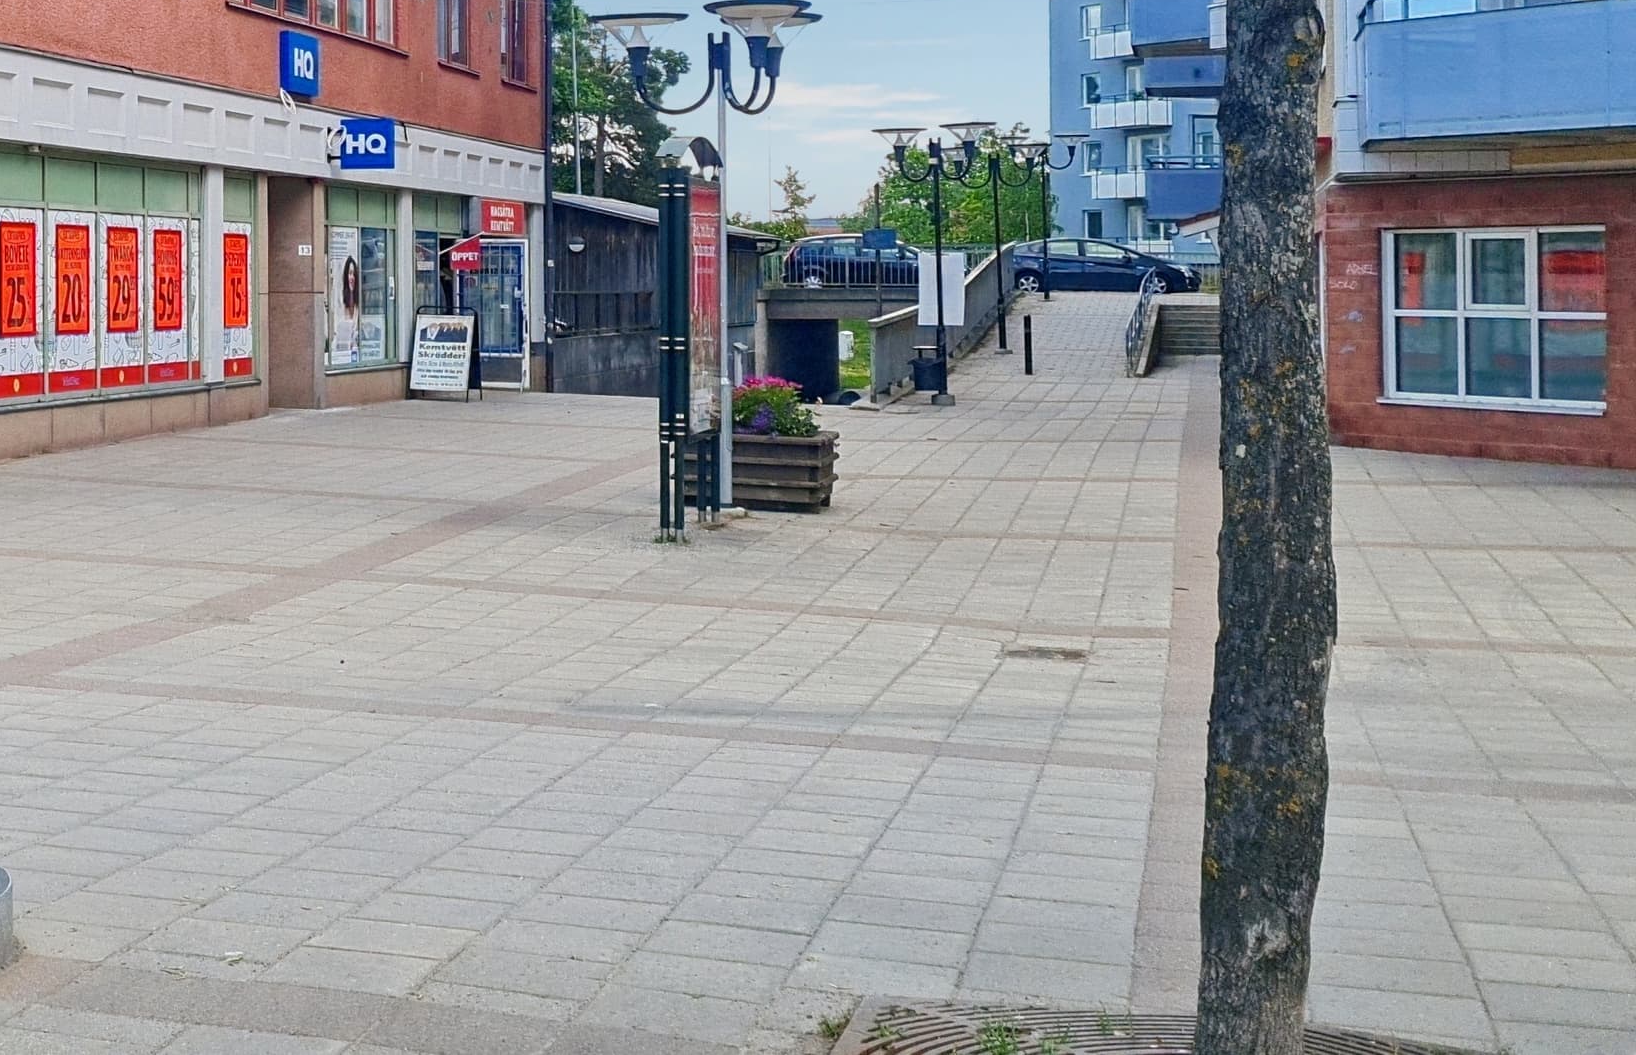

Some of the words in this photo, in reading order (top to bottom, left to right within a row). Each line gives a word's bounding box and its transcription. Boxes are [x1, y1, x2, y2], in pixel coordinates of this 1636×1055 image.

[293, 47, 315, 80] HQ
[346, 133, 387, 155] HQ
[7, 276, 27, 328] 25
[62, 273, 82, 324] 20
[112, 274, 130, 321] 29
[158, 276, 175, 321] 59
[230, 277, 242, 319] 15
